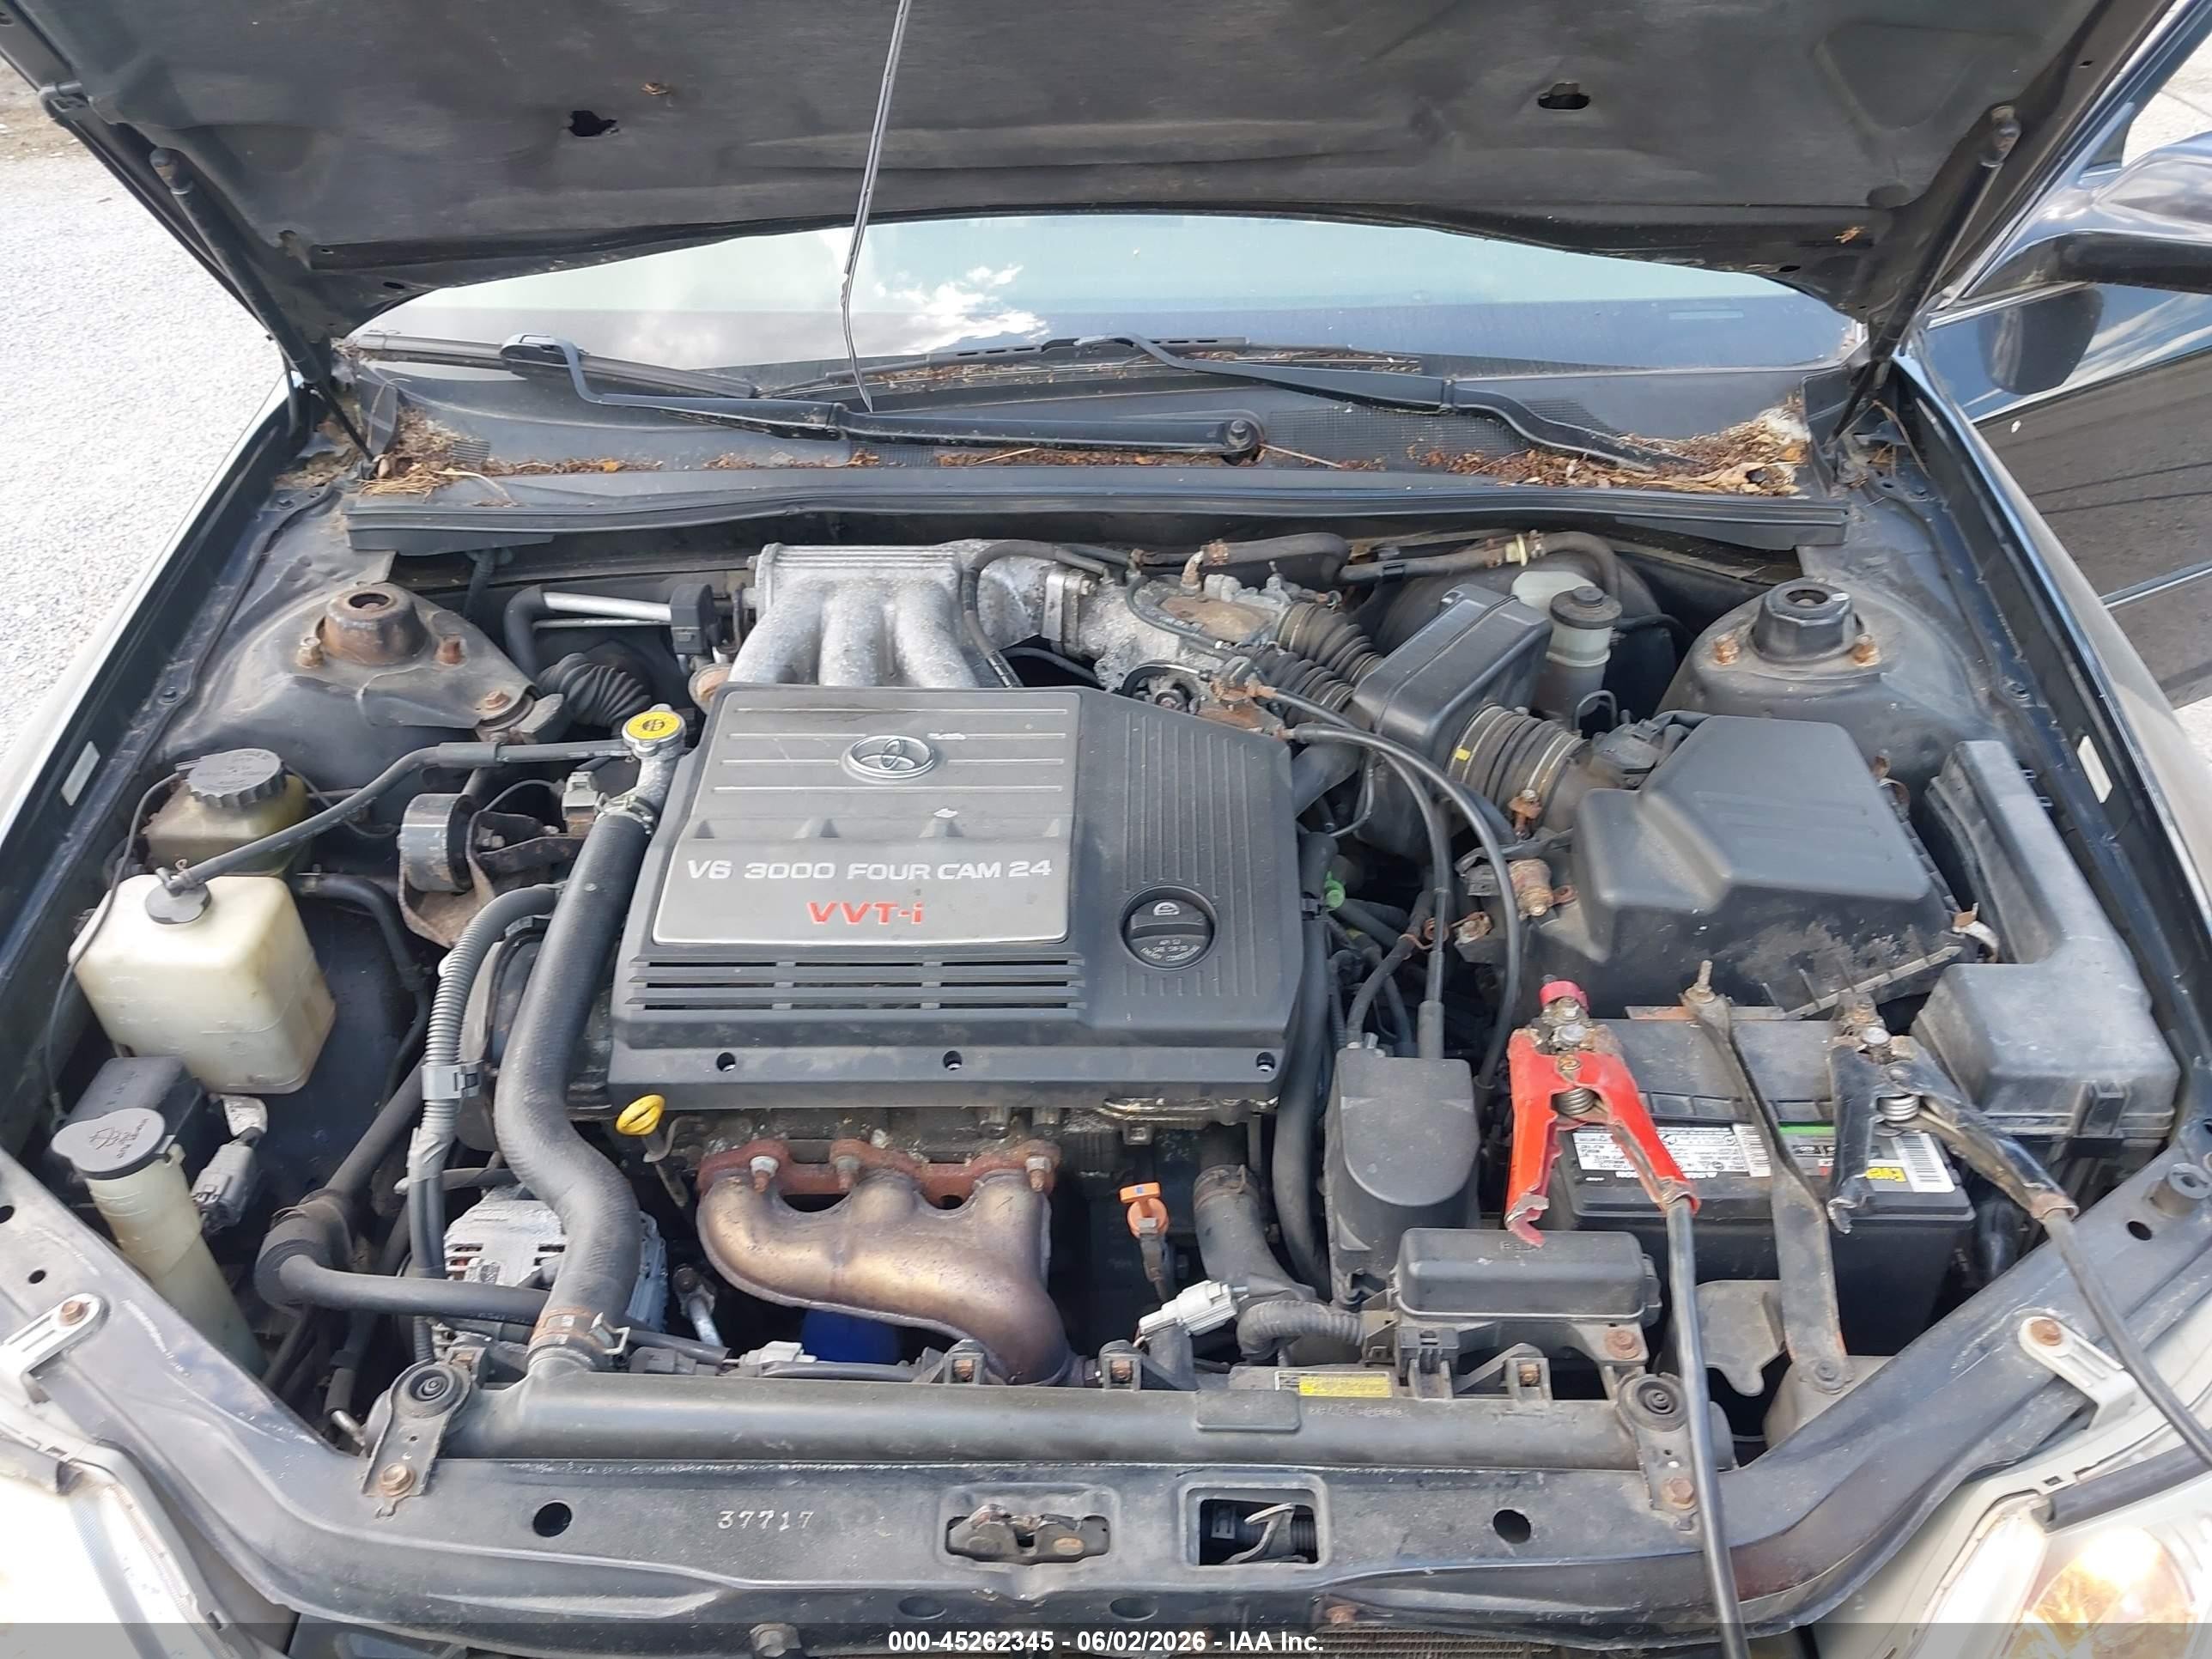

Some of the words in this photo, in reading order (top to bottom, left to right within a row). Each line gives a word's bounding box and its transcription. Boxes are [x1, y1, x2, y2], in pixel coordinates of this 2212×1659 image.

[688, 860, 732, 879] V6
[744, 862, 836, 879] 3000
[846, 863, 931, 880] FOUR
[937, 861, 1002, 880] CAM
[1008, 860, 1053, 878] 24
[806, 901, 924, 926] VVT-i
[718, 1510, 814, 1532] 37717
